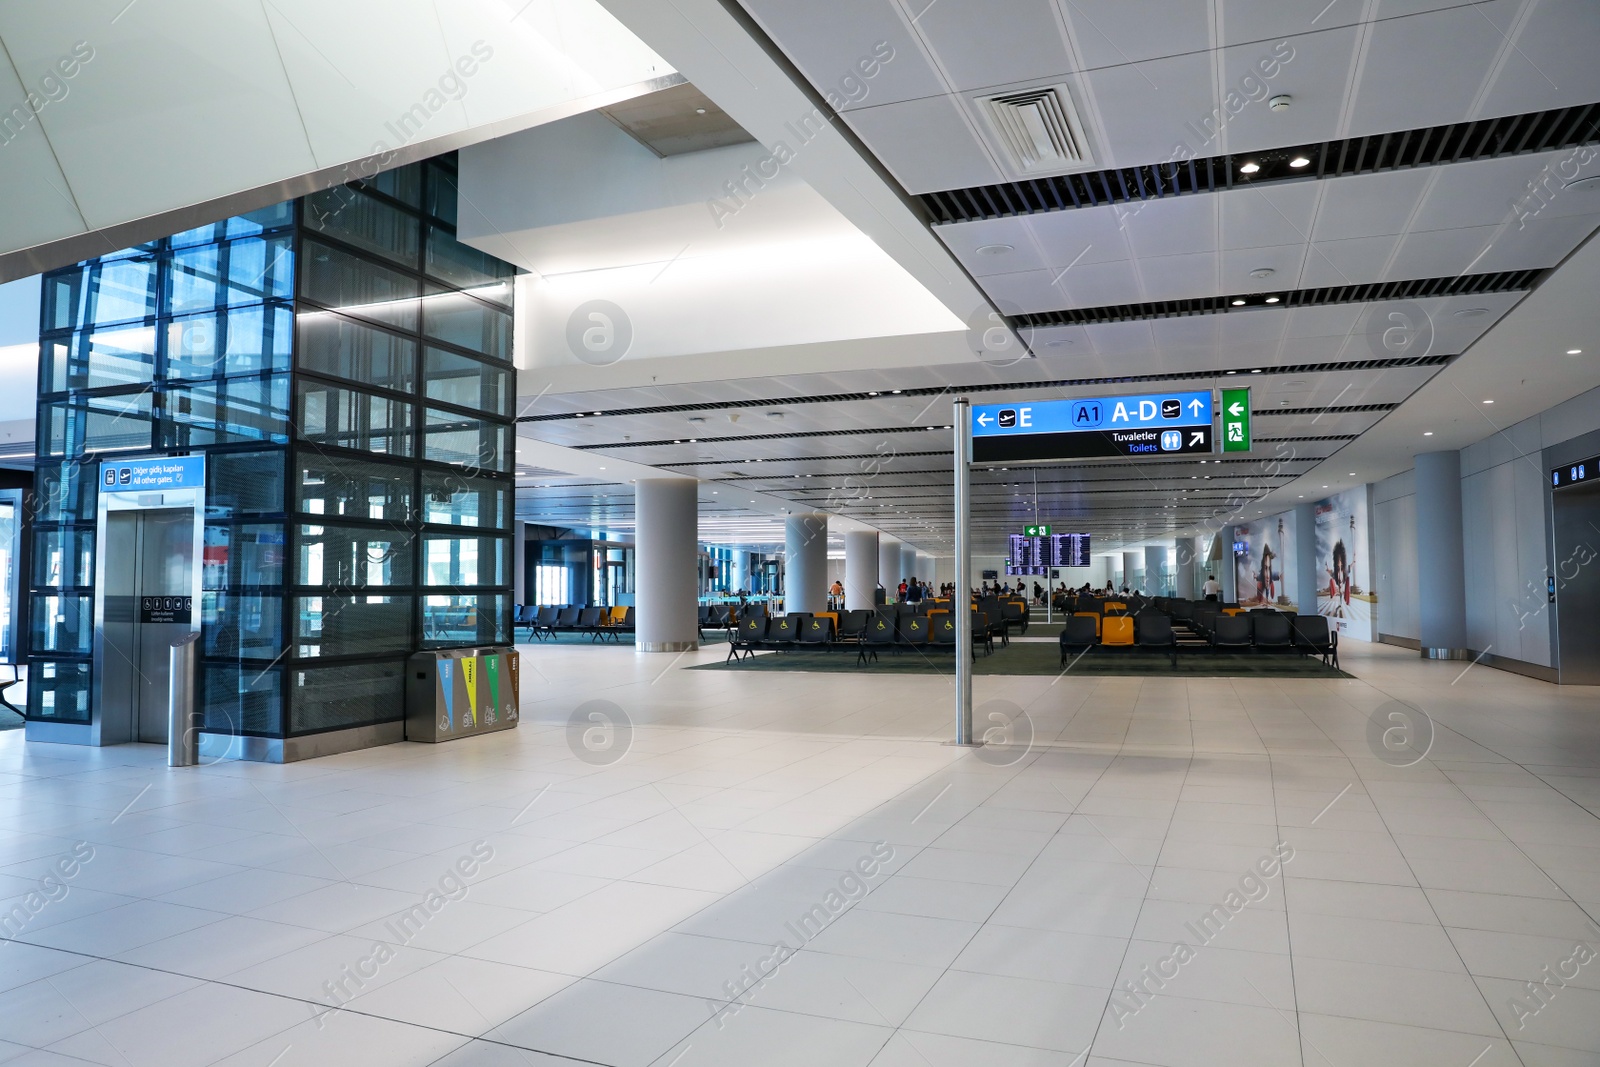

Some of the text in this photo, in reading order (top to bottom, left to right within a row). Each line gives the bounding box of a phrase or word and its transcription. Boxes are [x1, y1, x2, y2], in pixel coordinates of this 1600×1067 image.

[1076, 406, 1099, 422] A1
[1111, 400, 1157, 422] A-D
[1020, 407, 1032, 428] E
[1113, 432, 1157, 442] Tuvaletler
[1128, 443, 1157, 453] Toilets
[133, 467, 148, 476] Diğer
[149, 465, 163, 475] gidiş
[133, 476, 173, 485] All other gates
